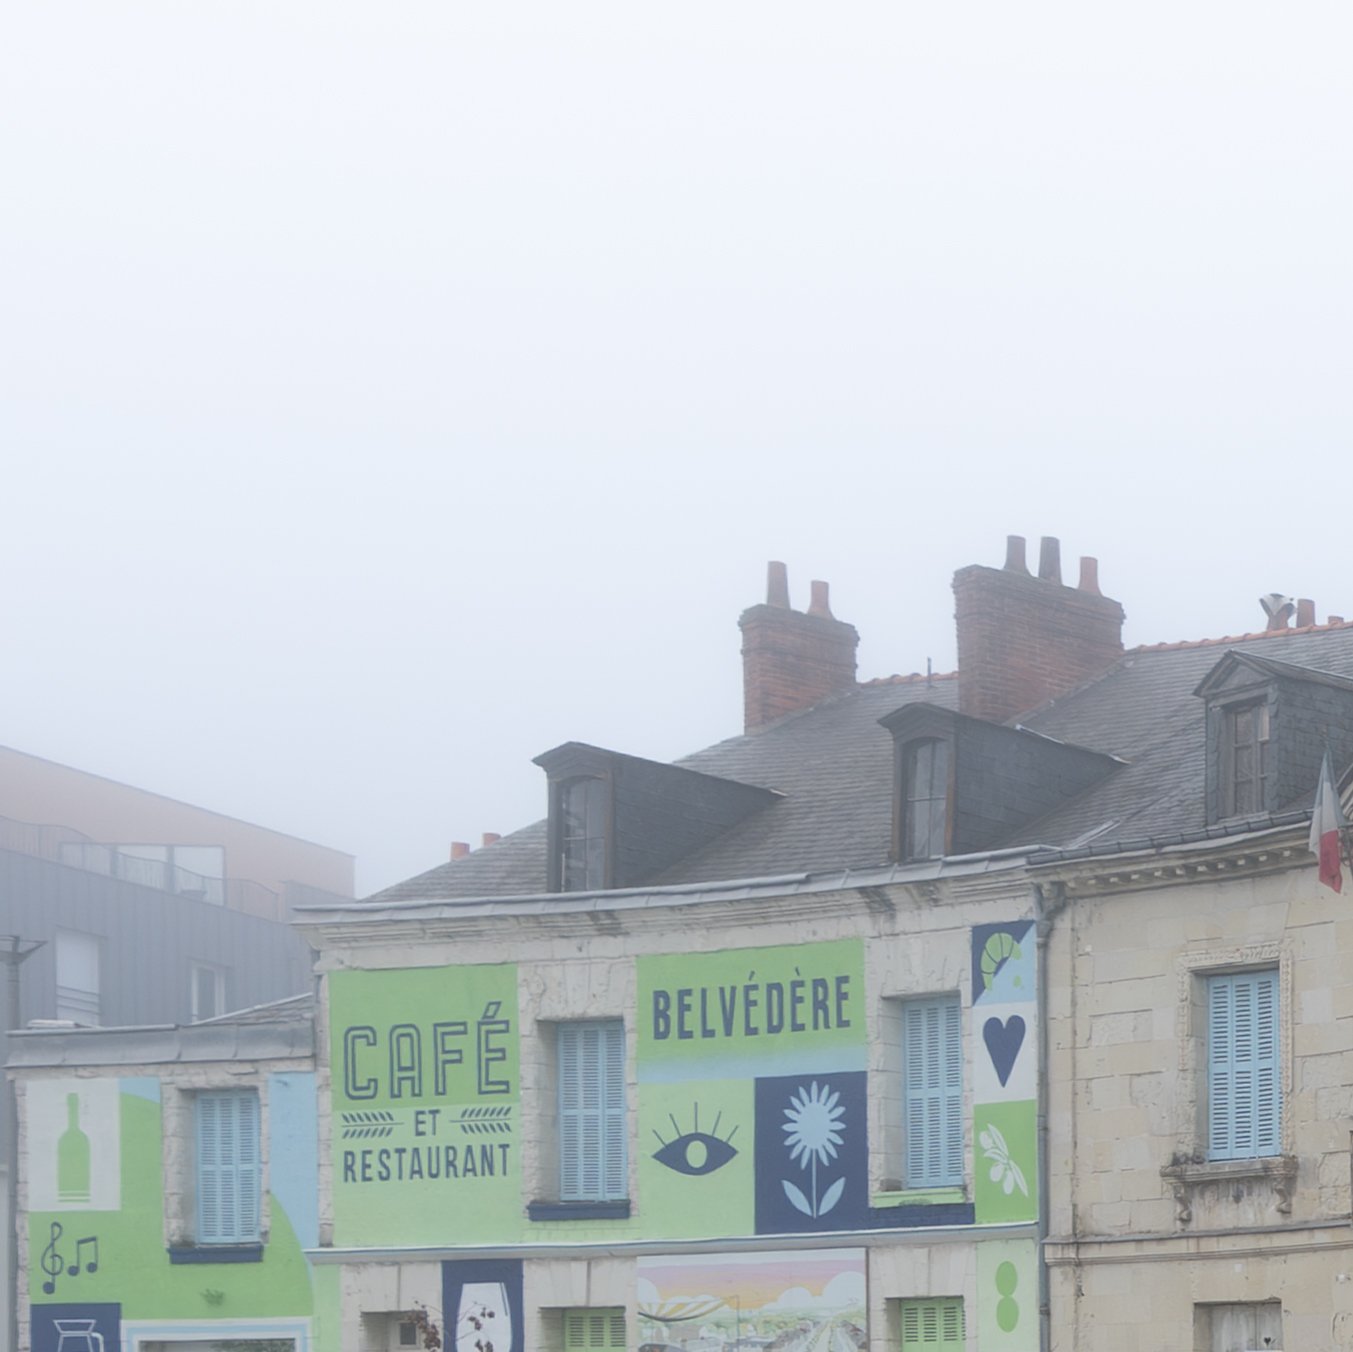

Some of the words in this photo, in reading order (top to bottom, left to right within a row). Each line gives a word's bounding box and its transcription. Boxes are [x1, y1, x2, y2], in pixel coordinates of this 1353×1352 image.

[652, 966, 851, 1041] BELVÉDÈRE
[343, 1001, 511, 1101] CAFÉ
[414, 1108, 441, 1137] ET
[343, 1143, 511, 1183] RESTAURANT
